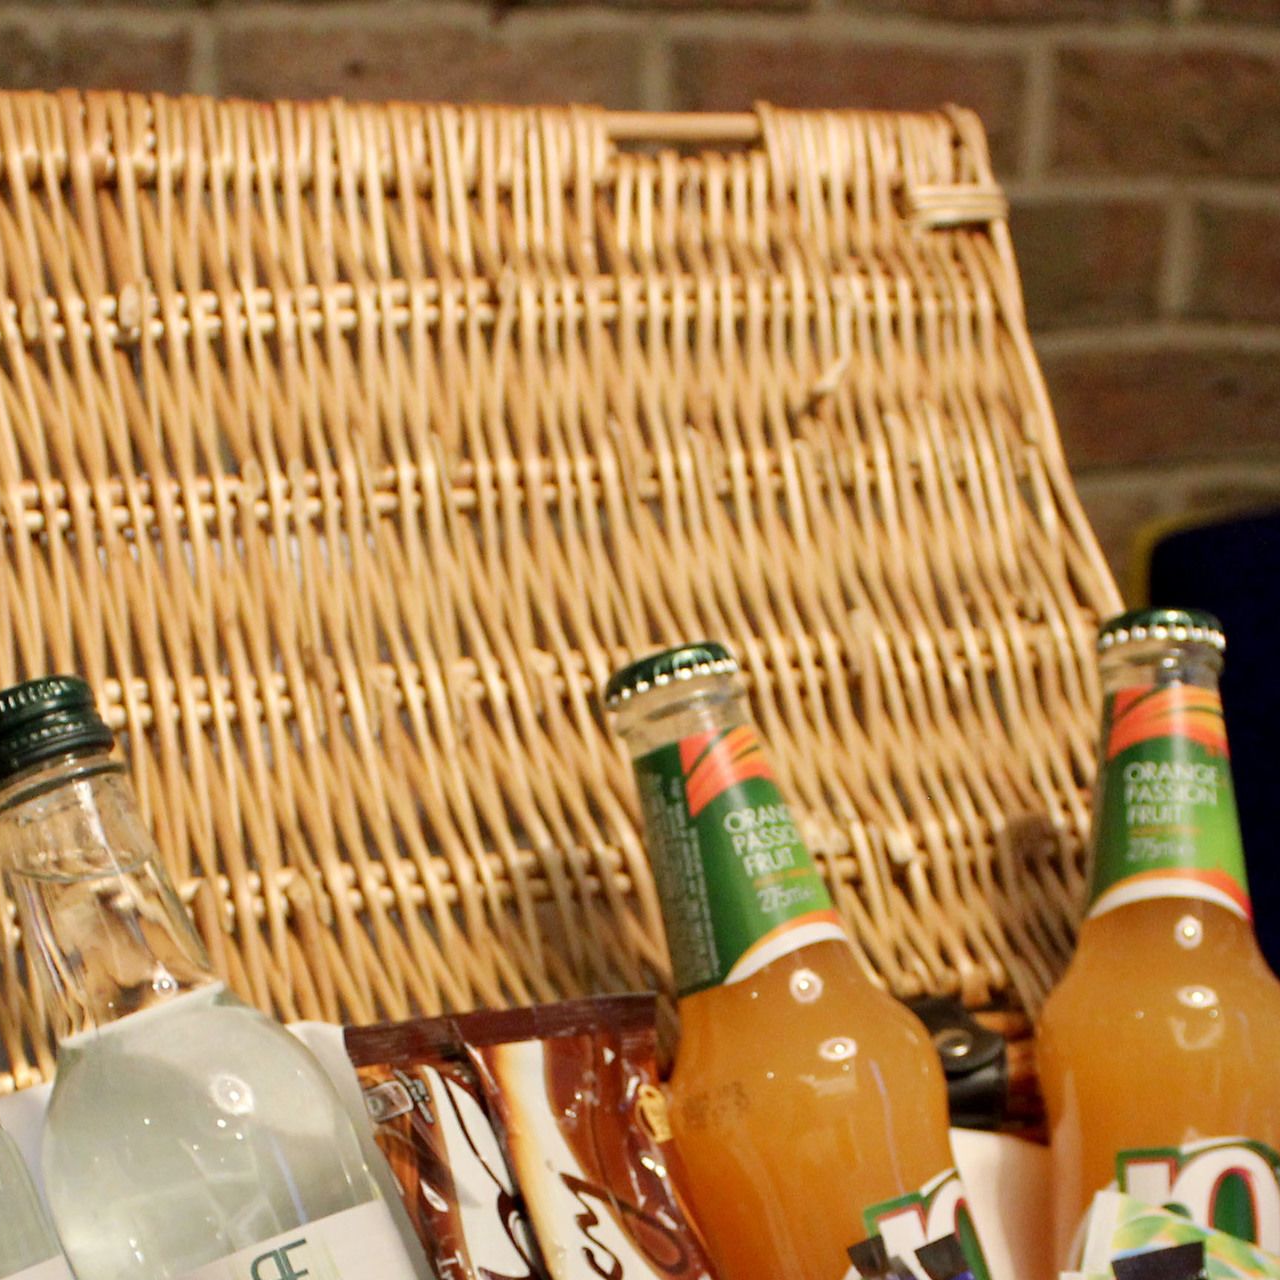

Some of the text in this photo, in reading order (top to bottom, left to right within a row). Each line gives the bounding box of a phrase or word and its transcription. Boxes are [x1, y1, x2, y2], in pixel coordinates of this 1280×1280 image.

[1123, 783, 1218, 806] PASSION
[1126, 804, 1184, 825] FRUIT
[742, 848, 796, 878] FRUIT
